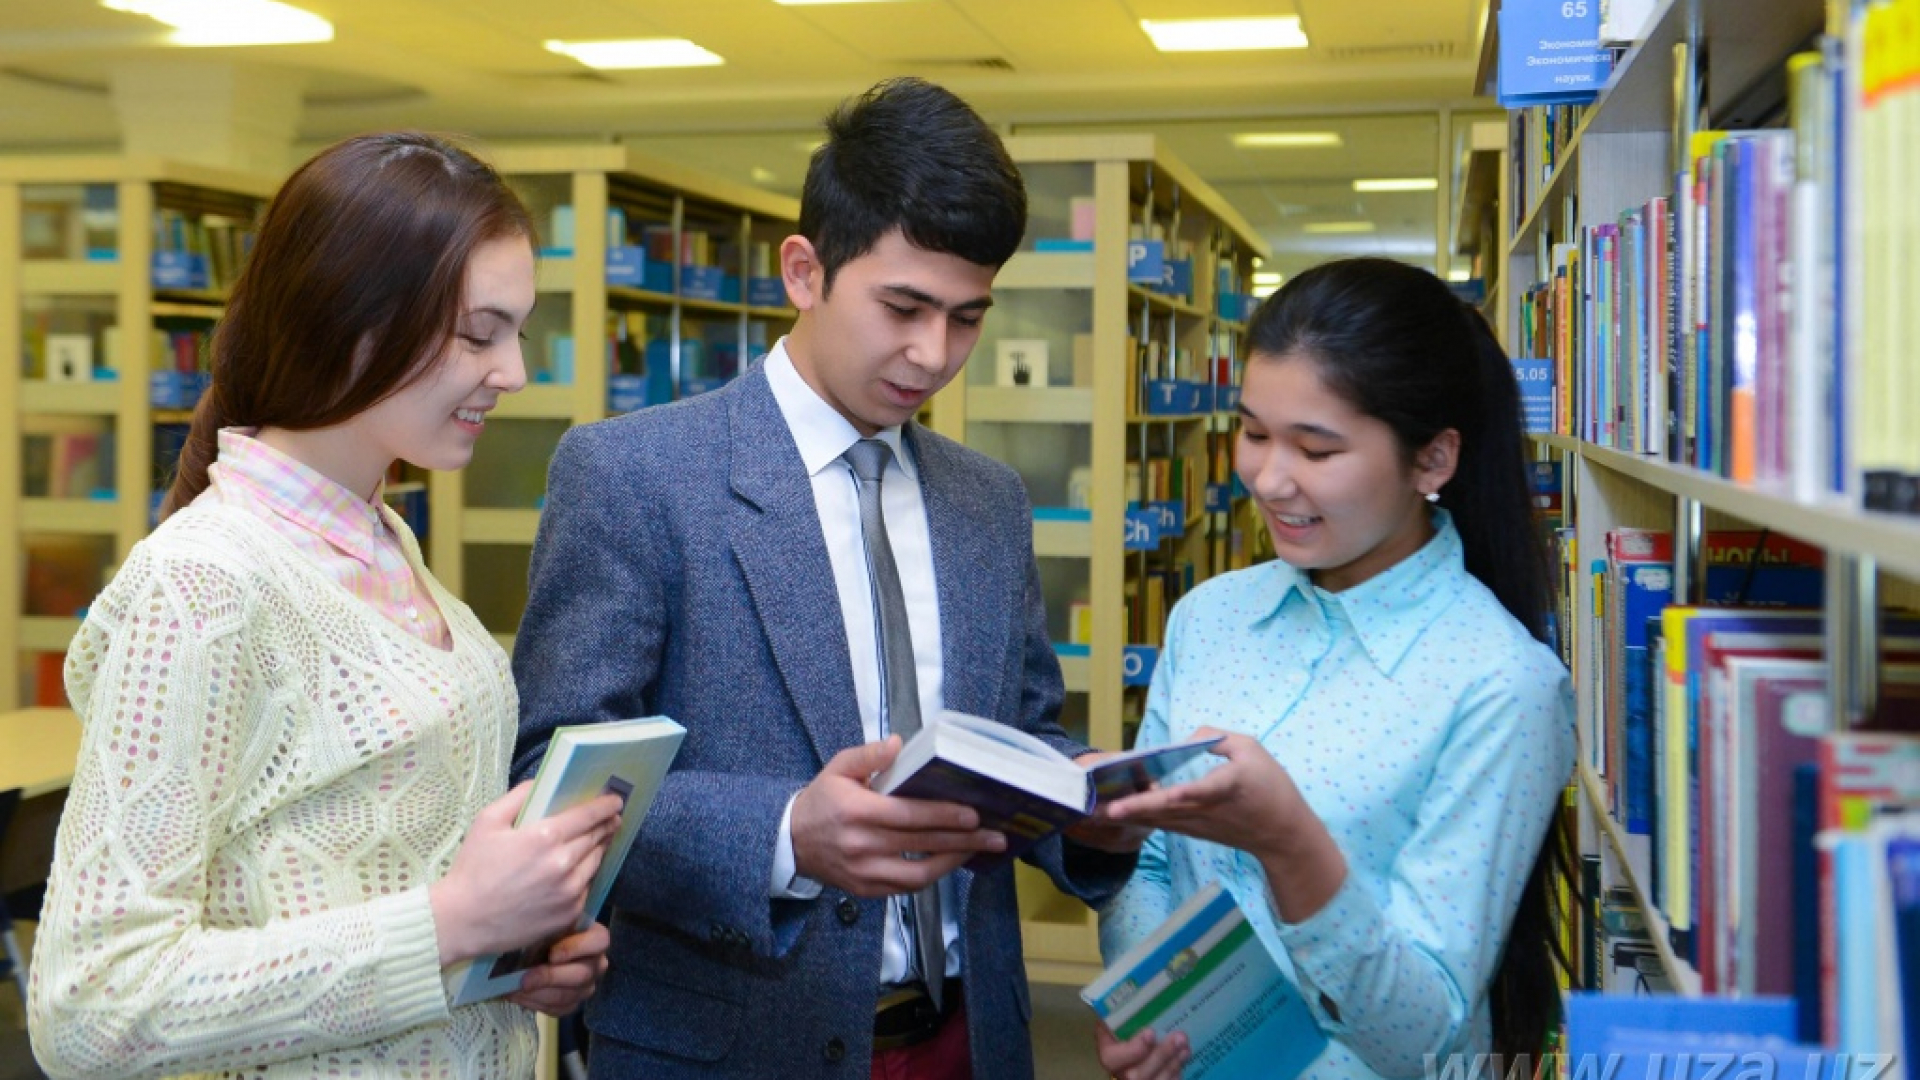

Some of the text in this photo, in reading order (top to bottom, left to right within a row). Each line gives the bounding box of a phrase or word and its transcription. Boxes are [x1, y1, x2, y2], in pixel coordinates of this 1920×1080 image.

[1562, 1, 1588, 18] 65
[1129, 244, 1147, 269] P
[1161, 382, 1178, 406] T
